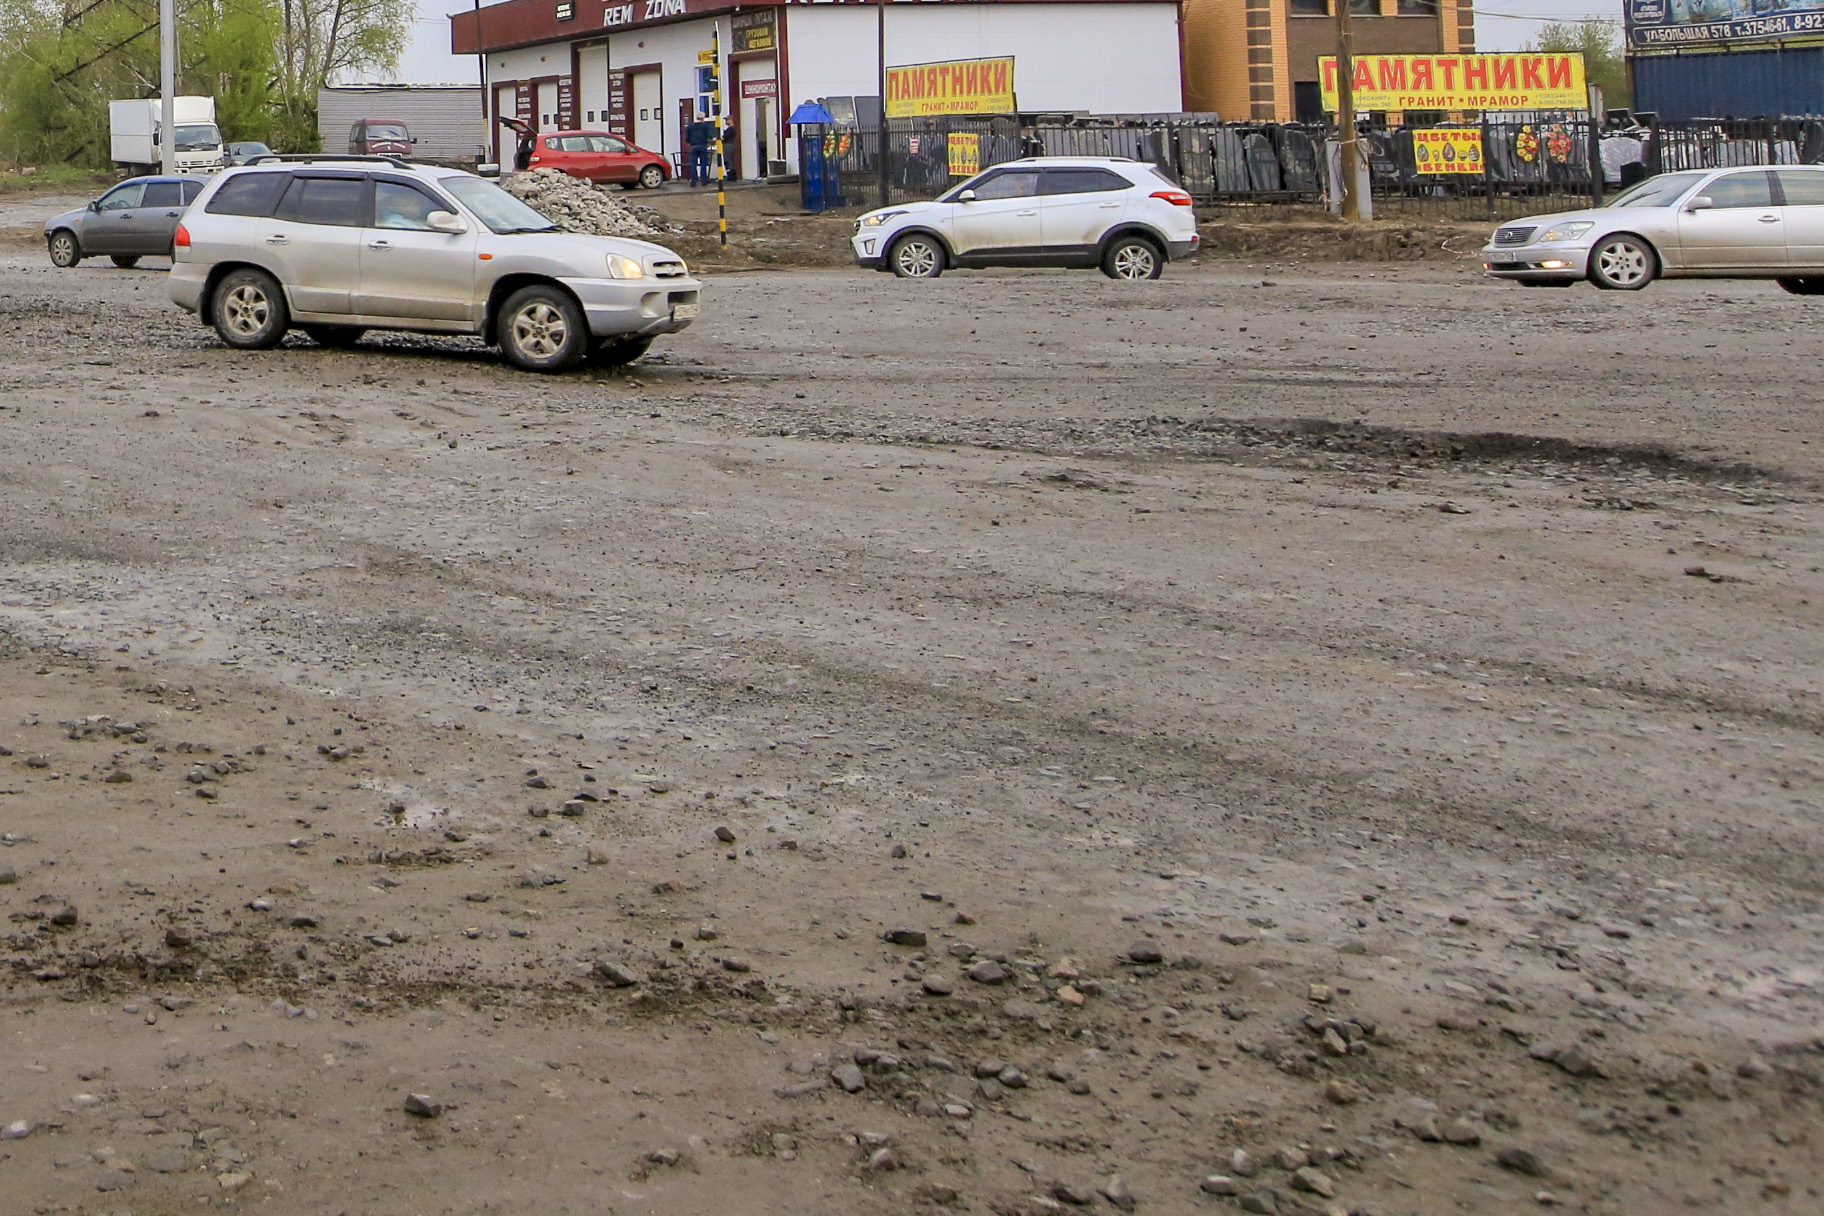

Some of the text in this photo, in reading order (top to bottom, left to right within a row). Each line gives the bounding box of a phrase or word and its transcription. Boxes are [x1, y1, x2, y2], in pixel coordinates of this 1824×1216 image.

[604, 4, 633, 27] REM
[1711, 25, 1731, 38] 578
[1794, 14, 1824, 29] 8-92
[889, 63, 1007, 100] ПАМЯТНИКИ
[921, 103, 945, 112] ГРАНИТ
[950, 101, 978, 111] МРАМОР
[1399, 97, 1454, 106] ГРАНИТ
[1468, 96, 1528, 105] МРАМОР
